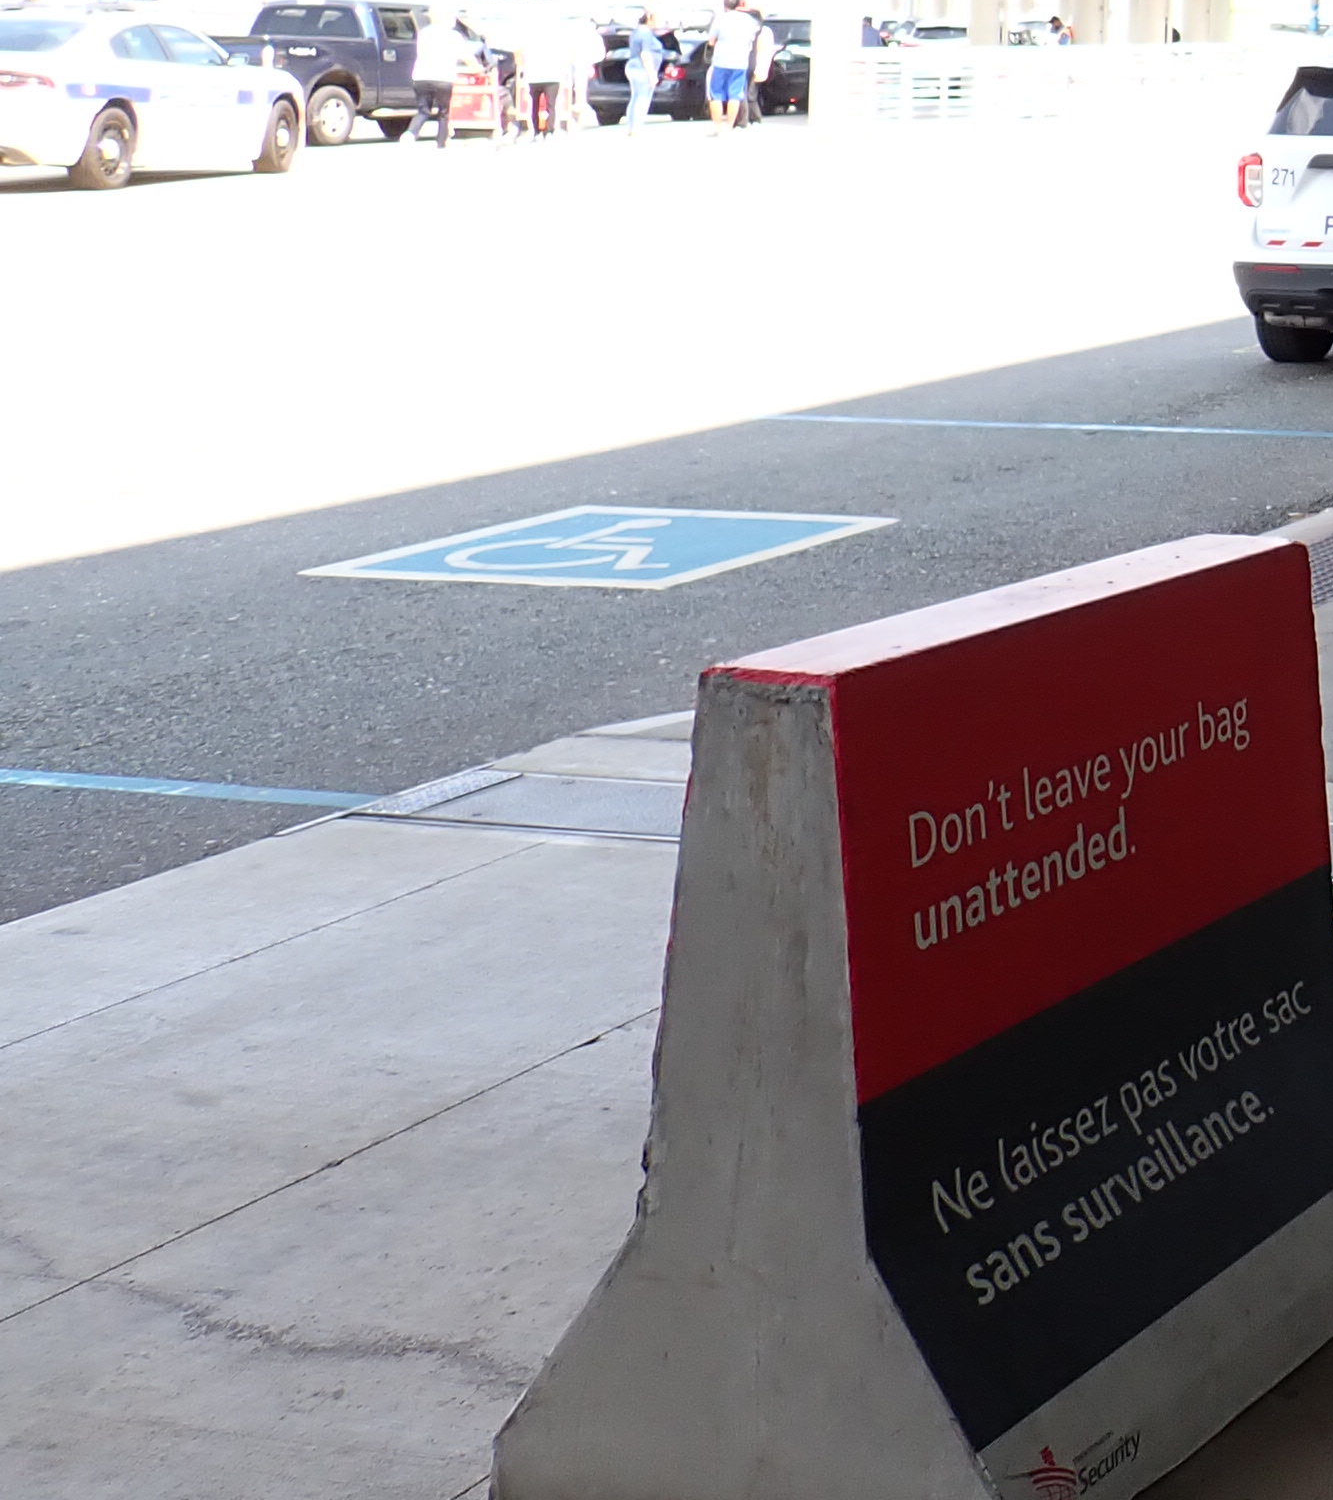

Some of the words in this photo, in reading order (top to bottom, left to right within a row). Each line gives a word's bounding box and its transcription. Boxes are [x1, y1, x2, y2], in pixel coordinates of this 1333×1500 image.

[1271, 167, 1296, 187] 271
[1023, 753, 1112, 821] leave
[1119, 720, 1190, 799] your
[1197, 697, 1250, 751] bag
[914, 805, 1137, 950] unattended.
[931, 1166, 995, 1234] Ne
[998, 1096, 1119, 1192] laissez
[1119, 1059, 1178, 1135] pas
[1178, 1011, 1261, 1082] votre
[1262, 980, 1312, 1034] sac
[966, 1220, 1062, 1305] sans
[1061, 1090, 1275, 1243] surveillance.
[1077, 1430, 1141, 1495] Security
